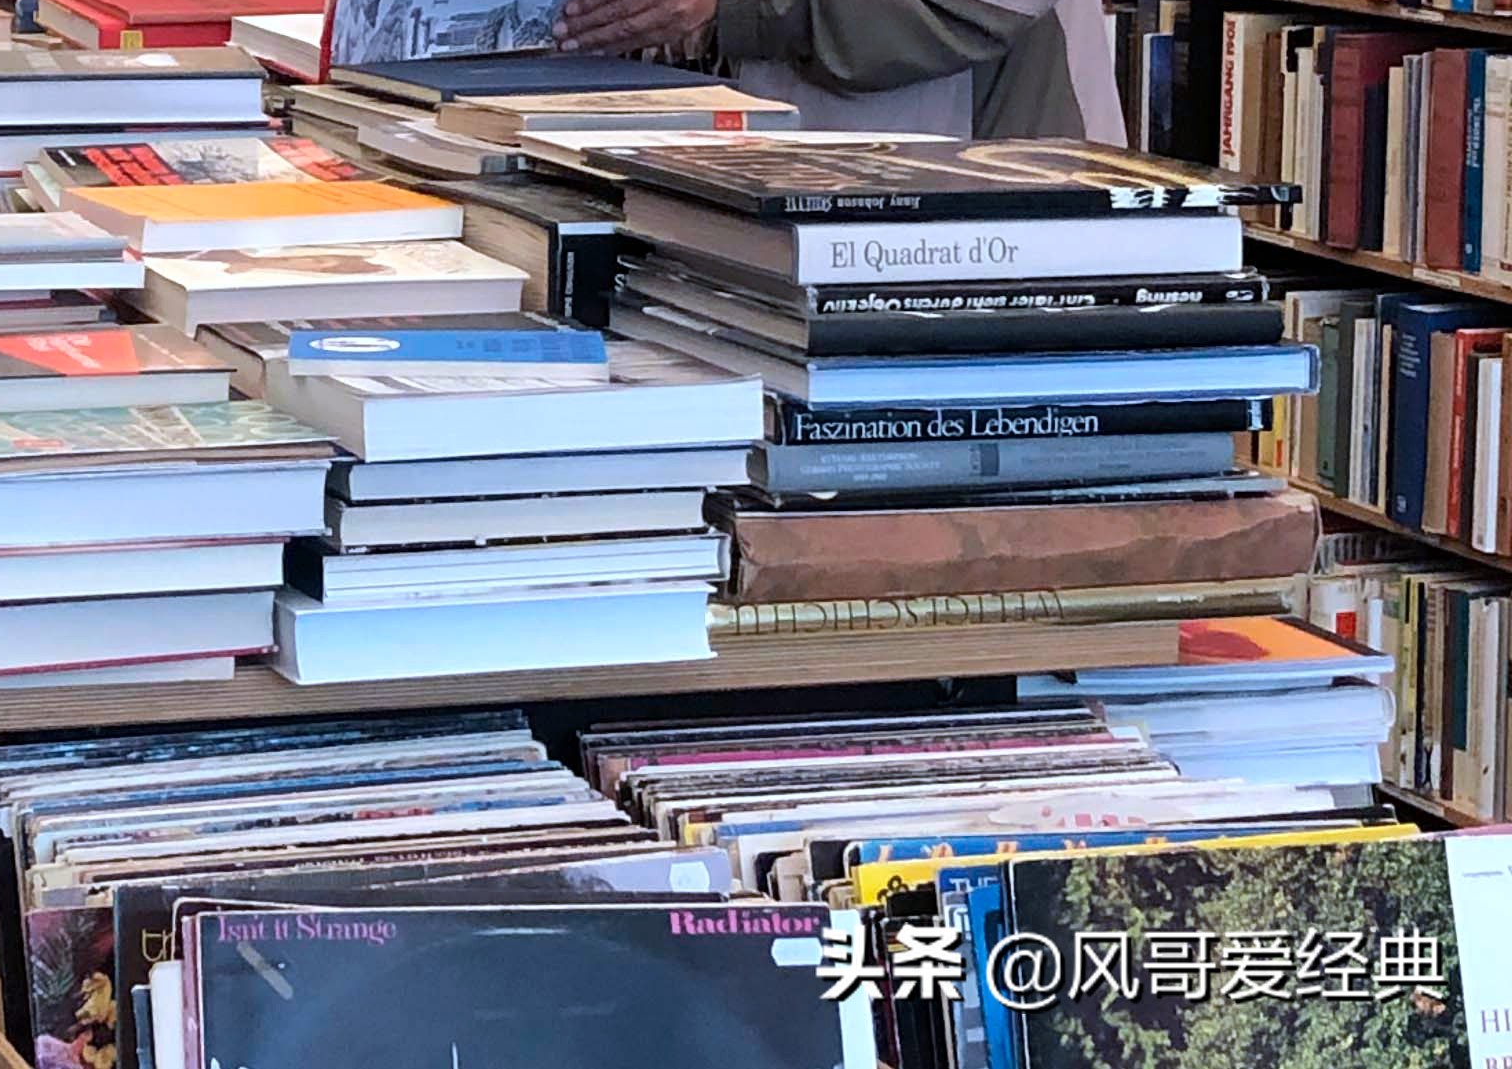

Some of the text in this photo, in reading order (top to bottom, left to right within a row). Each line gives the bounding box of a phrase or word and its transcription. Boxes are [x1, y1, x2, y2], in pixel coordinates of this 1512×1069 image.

[836, 194, 886, 212] Johnson
[830, 237, 1020, 270] El Quadrat d'Or
[795, 407, 1099, 442] Faszination des Lebendigen
[295, 914, 397, 944] Strange
[669, 911, 821, 936] Radiator
